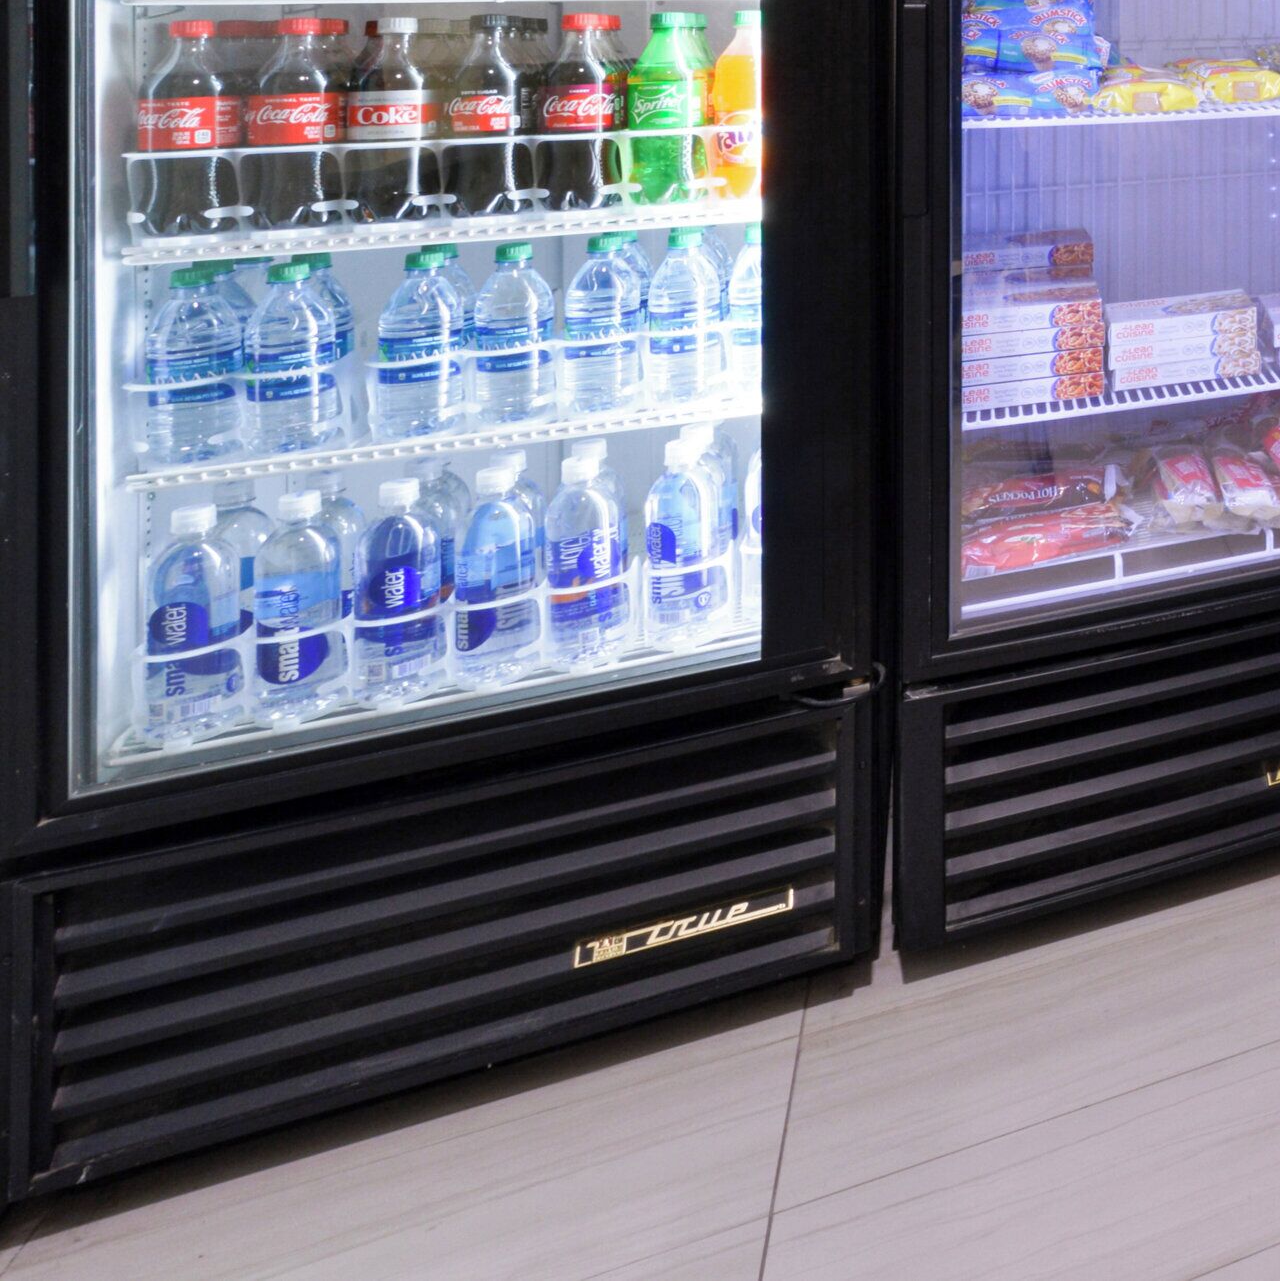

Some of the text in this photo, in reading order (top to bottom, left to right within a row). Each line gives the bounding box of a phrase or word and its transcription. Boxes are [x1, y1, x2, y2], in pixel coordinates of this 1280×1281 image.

[1029, 8, 1088, 27] DRUMSTICK
[357, 105, 418, 125] Coke
[634, 94, 683, 116] Sprite
